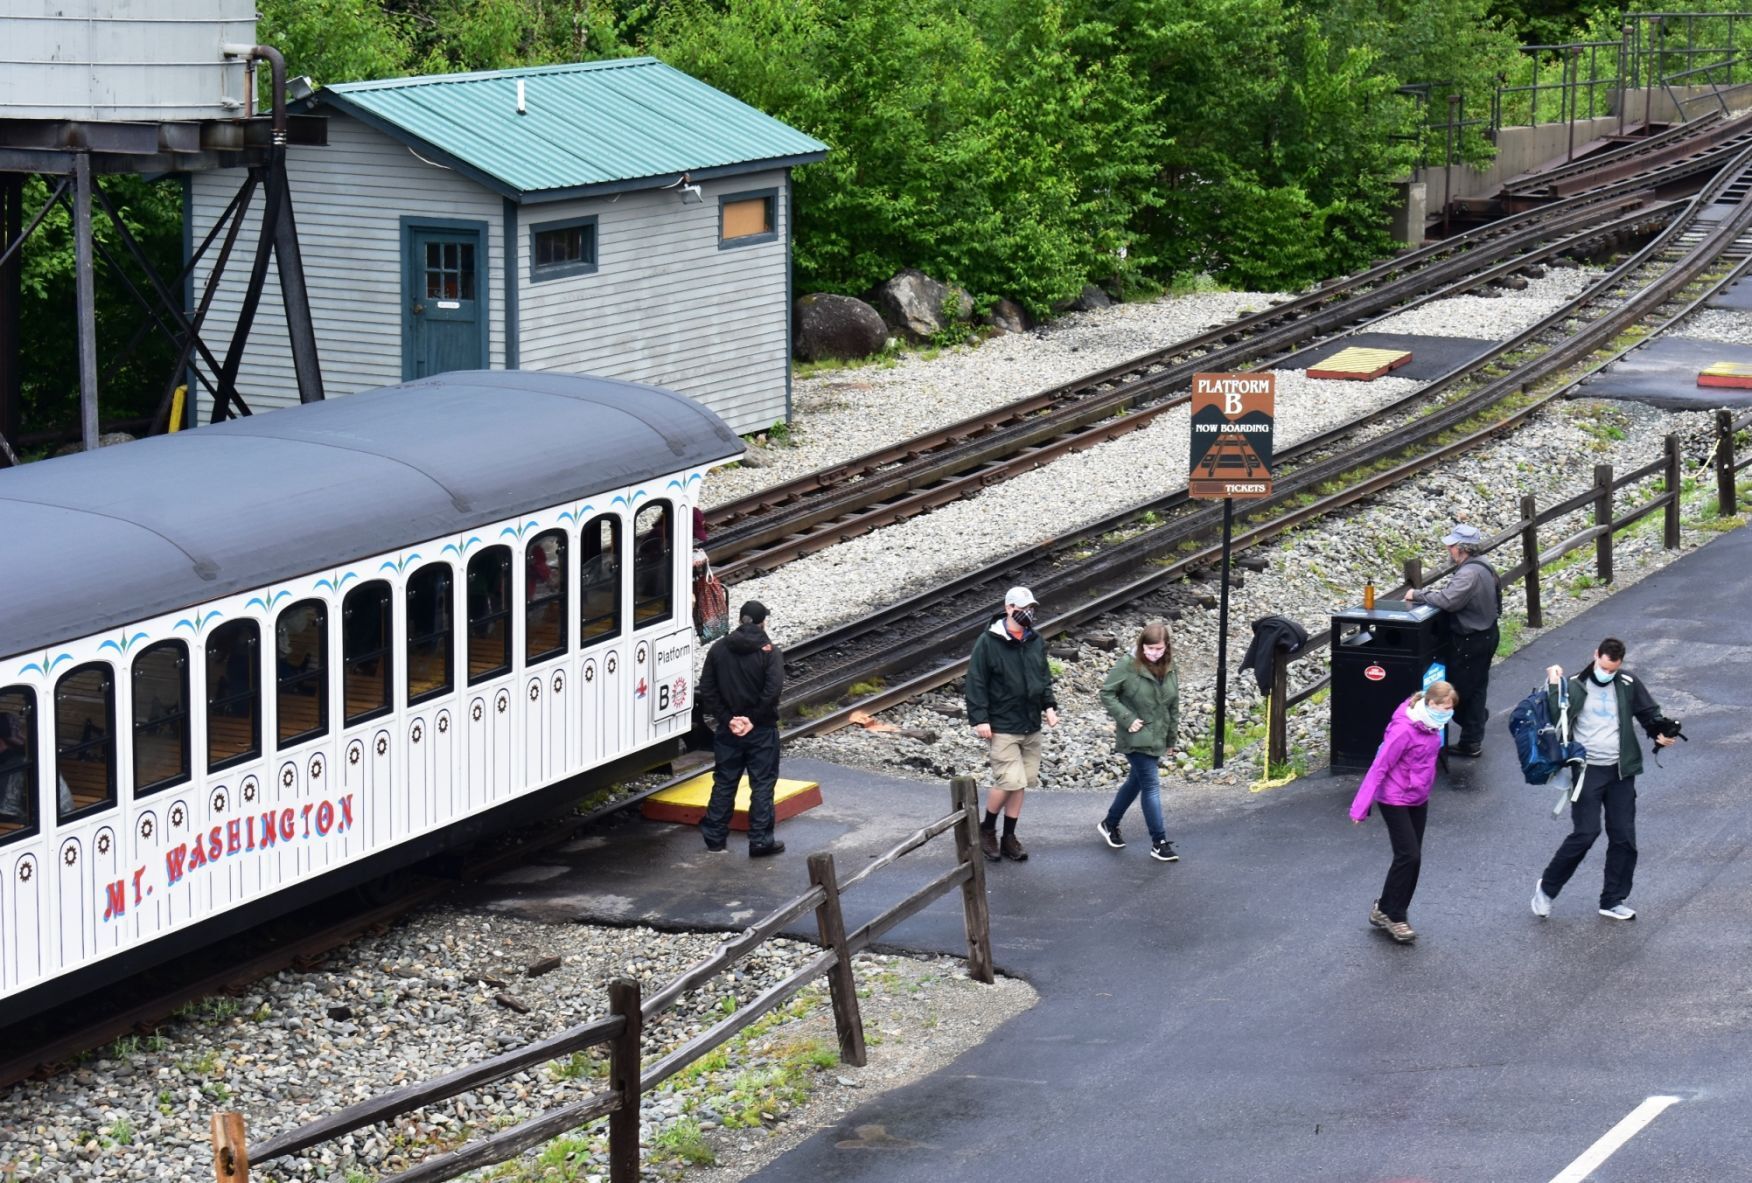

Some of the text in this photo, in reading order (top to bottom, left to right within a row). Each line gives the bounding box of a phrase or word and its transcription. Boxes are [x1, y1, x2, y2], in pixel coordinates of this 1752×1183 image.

[1198, 380, 1269, 393] PLATFORM
[1224, 394, 1243, 414] B
[1195, 424, 1269, 432] NOW BOARDING
[1225, 484, 1266, 493] TICKETS
[657, 644, 691, 665] Platform
[635, 677, 648, 699] 4
[659, 684, 669, 711] B
[103, 793, 353, 922] MT. WASHINGTON
